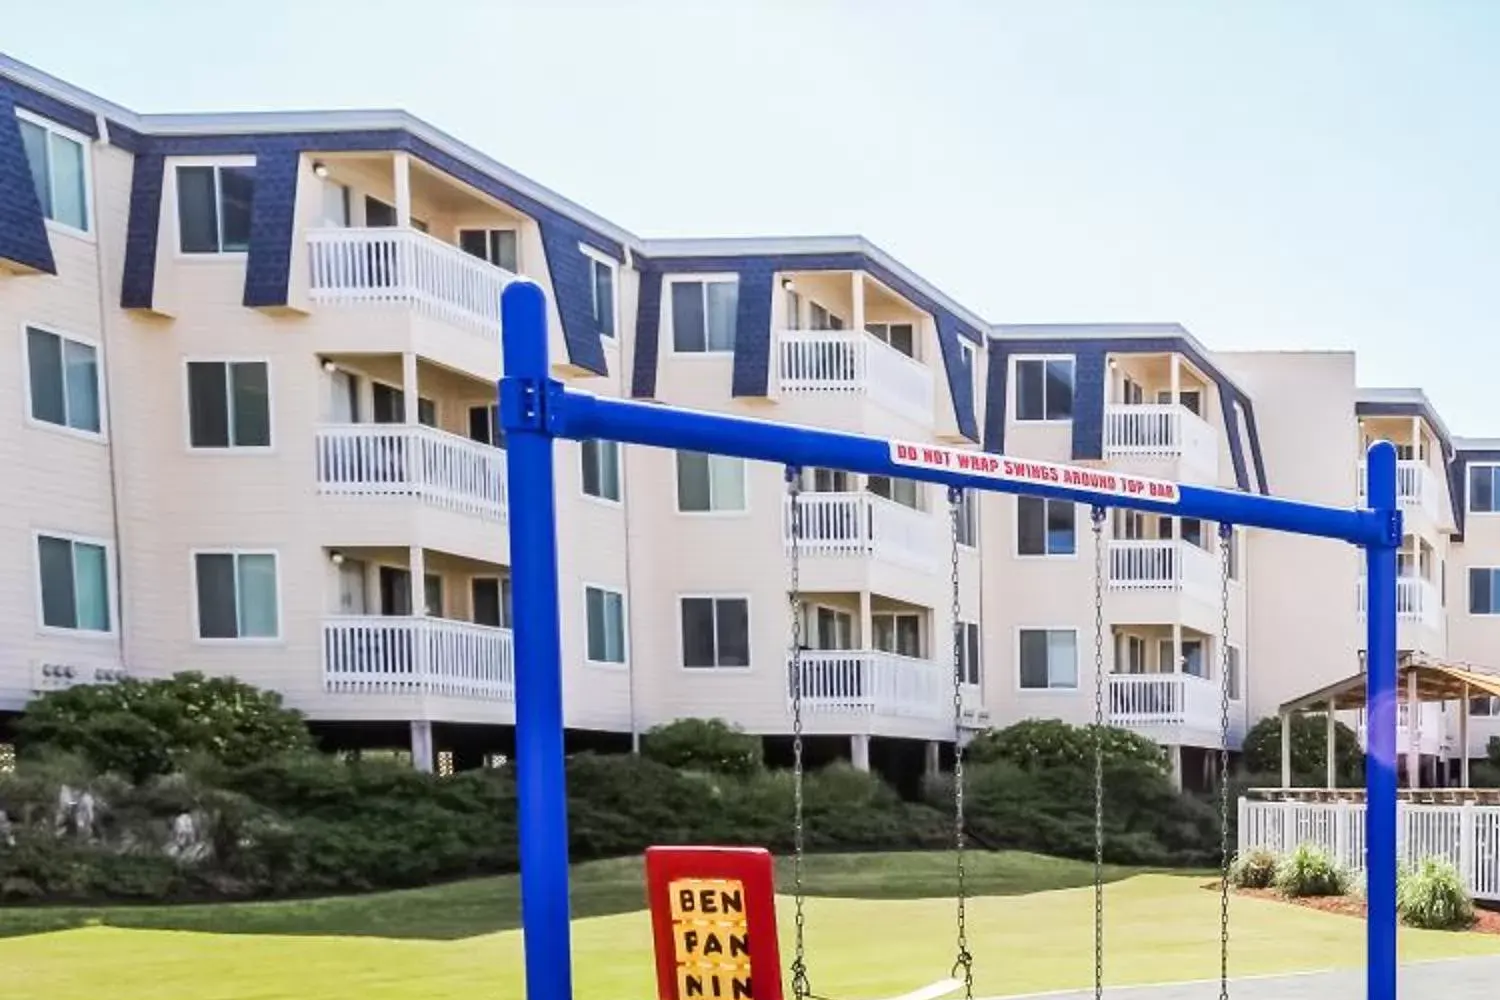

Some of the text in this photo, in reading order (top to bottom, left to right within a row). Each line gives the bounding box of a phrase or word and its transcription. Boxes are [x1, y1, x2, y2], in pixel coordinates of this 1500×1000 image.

[897, 444, 1175, 499] DO NOT WRAP SWINGS AROUND TOP BAR
[679, 889, 742, 914] BEN
[684, 930, 750, 957] PAN
[685, 975, 753, 1000] NIN
